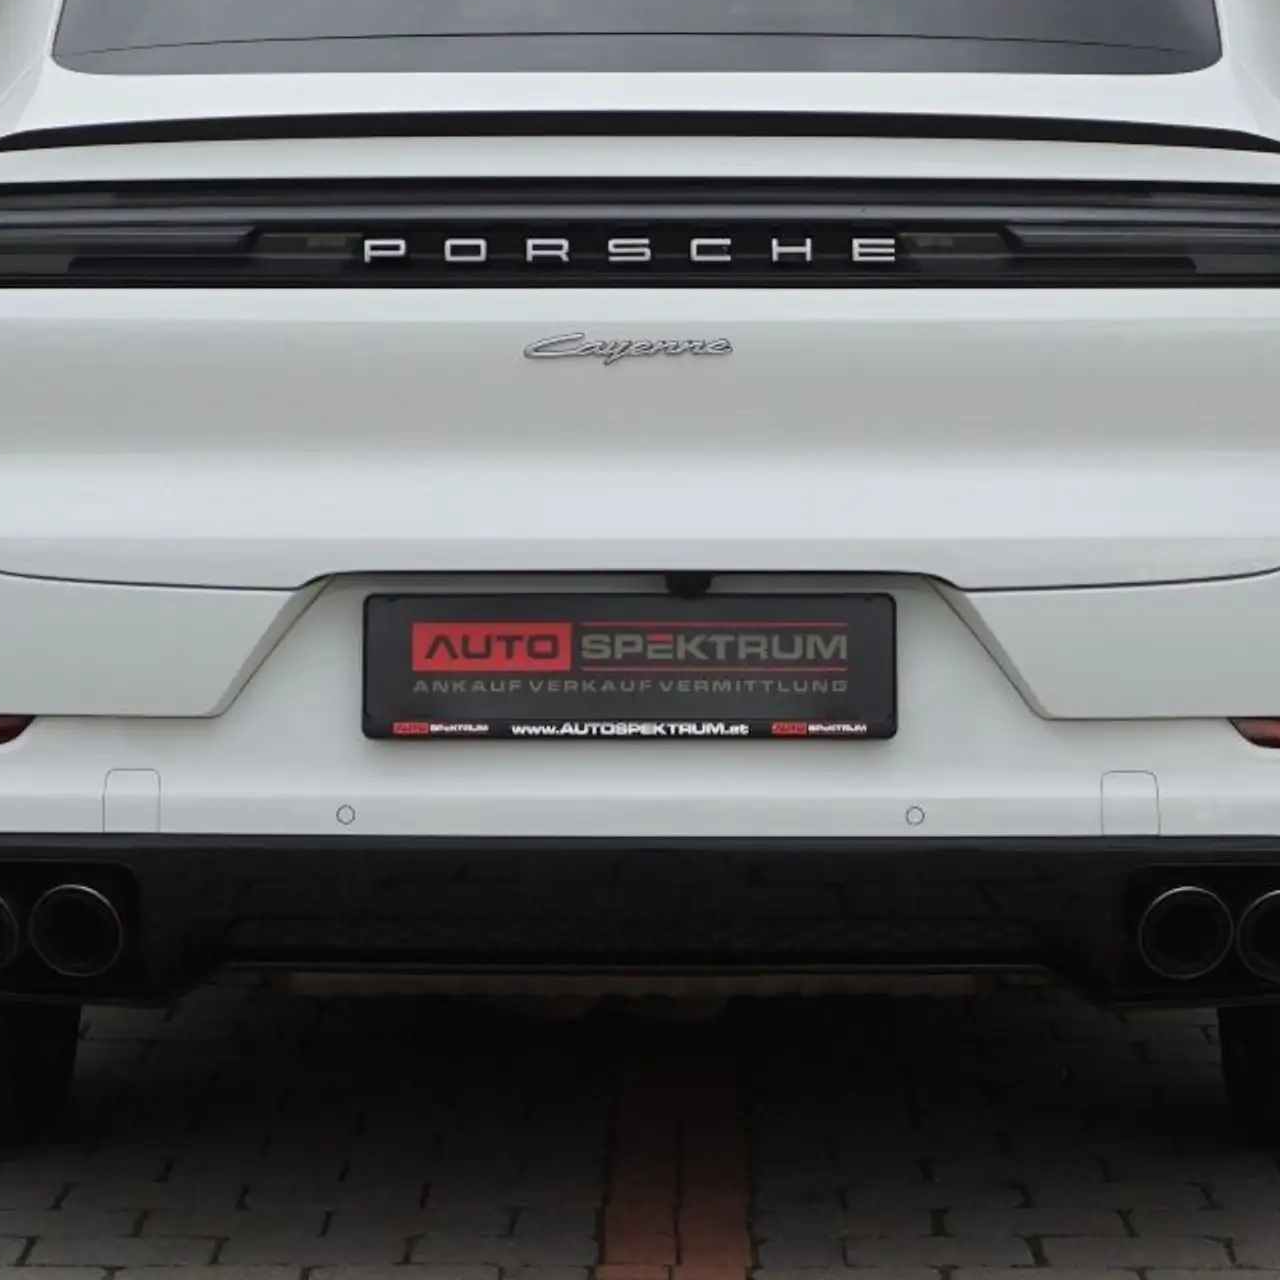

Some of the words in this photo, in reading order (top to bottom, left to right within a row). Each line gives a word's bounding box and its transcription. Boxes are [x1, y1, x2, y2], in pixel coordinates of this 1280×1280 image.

[363, 237, 896, 263] PORSCHE
[523, 332, 734, 366] Cayenne
[424, 634, 560, 659] AUTO
[582, 634, 847, 660] SPEKTRUM
[413, 679, 521, 693] ANKAUF
[528, 679, 652, 693] VERKAUF
[658, 679, 848, 693] VERMITTLUNG
[512, 721, 750, 736] www.AUTOSPEKTRUM.at
